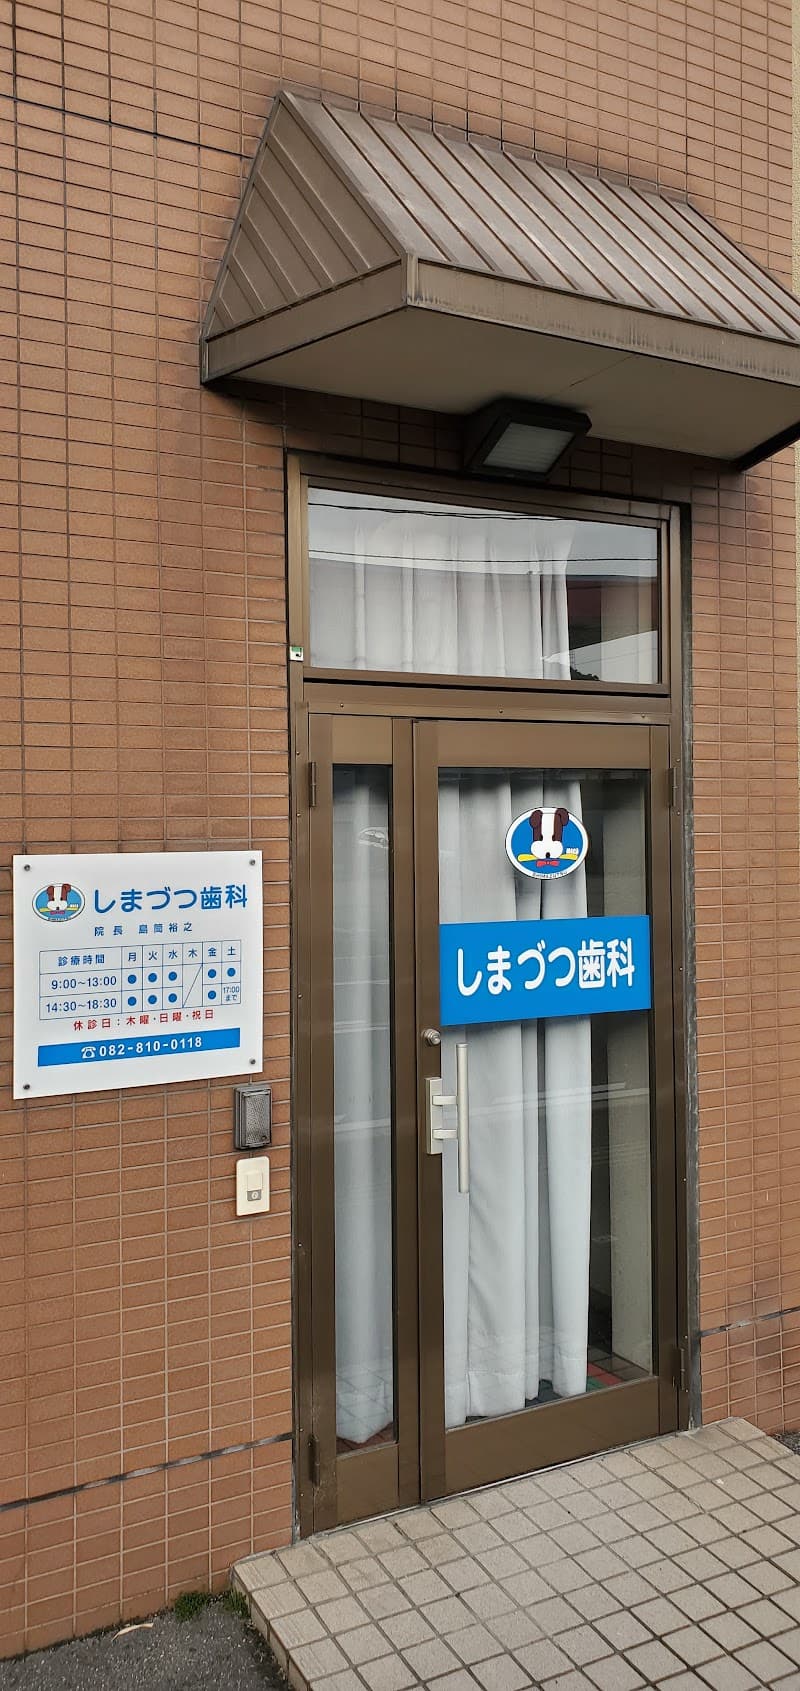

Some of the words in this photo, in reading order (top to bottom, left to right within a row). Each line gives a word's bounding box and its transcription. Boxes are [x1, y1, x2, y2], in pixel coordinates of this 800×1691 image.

[94, 884, 247, 914] しまづつ歯科
[94, 926, 123, 936] 院長
[58, 954, 105, 966] 診療時間
[128, 952, 137, 961] 月
[148, 952, 157, 961] 火
[168, 950, 178, 959] 水
[188, 948, 197, 957] 木
[208, 947, 217, 957] 金
[227, 947, 236, 955] 土
[457, 938, 634, 996] しまづつ歯科
[223, 986, 240, 994] 17:00
[100, 1037, 202, 1057] 082-810-0118
